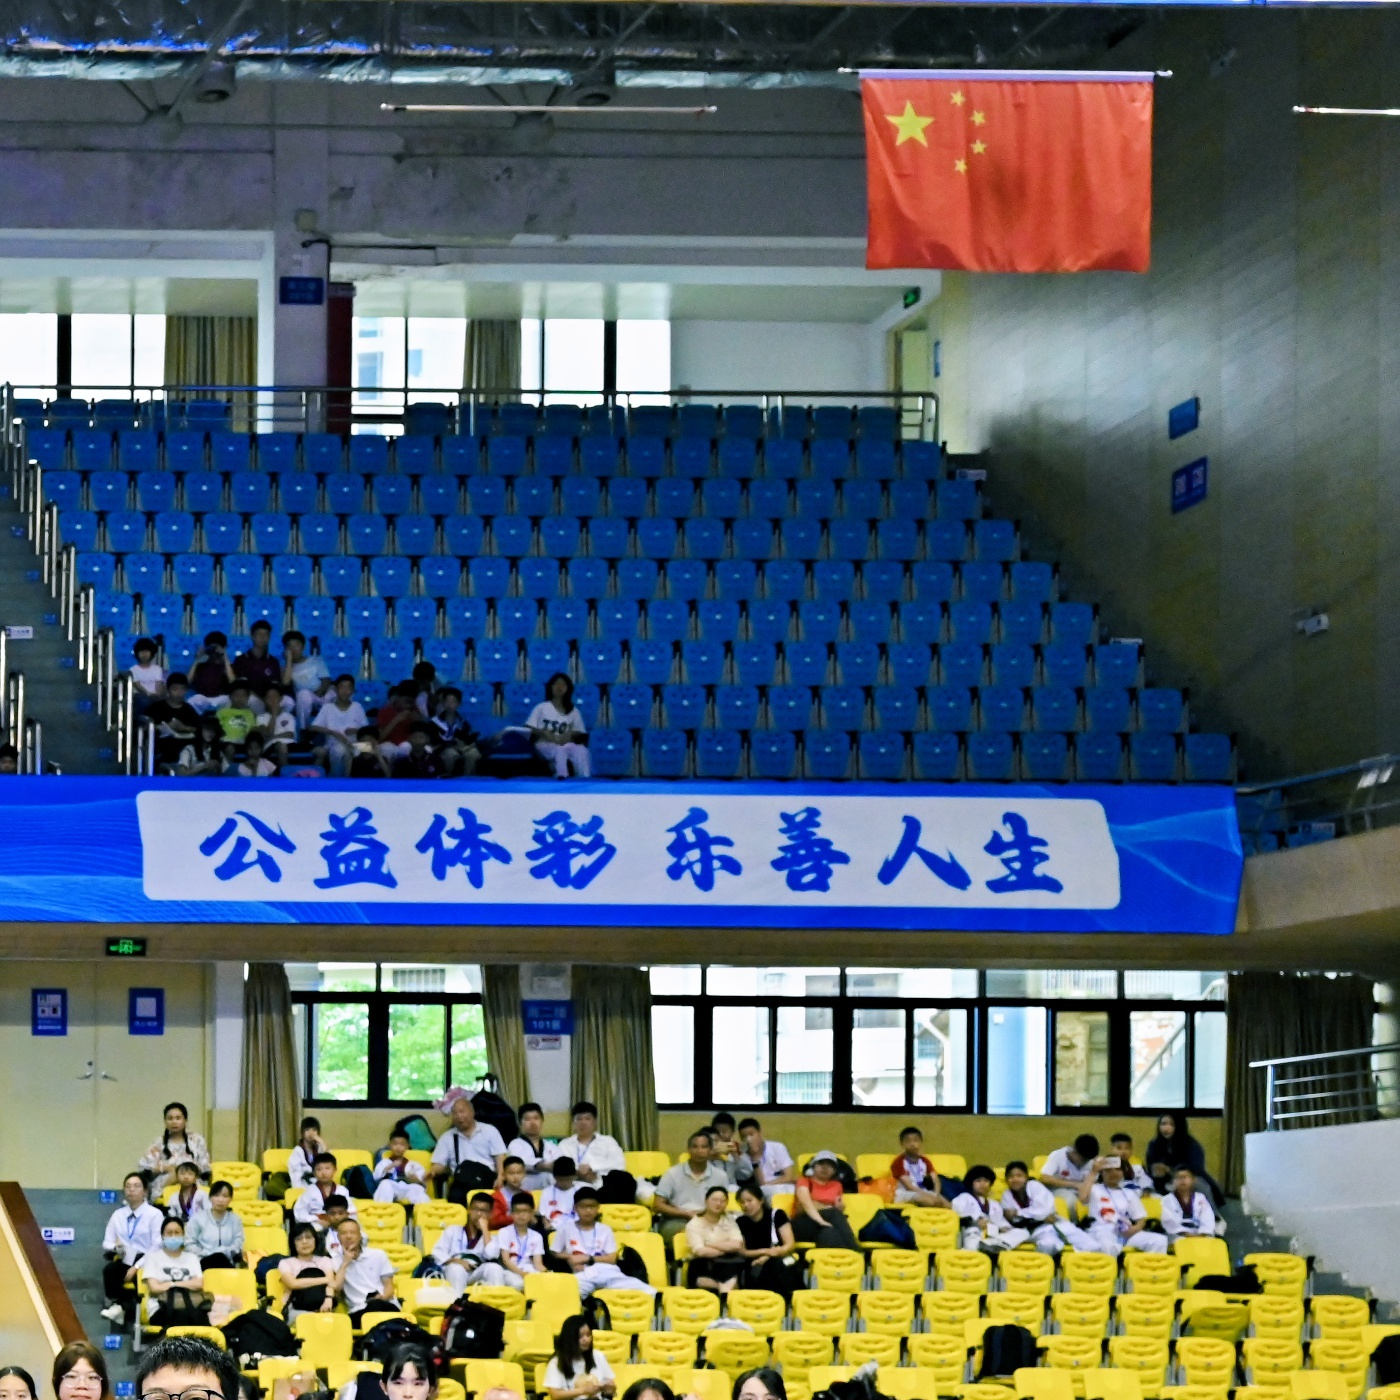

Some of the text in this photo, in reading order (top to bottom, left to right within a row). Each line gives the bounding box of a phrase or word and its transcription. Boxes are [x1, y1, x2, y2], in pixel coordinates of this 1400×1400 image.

[198, 805, 1066, 896] 公益体彩 乐善人生
